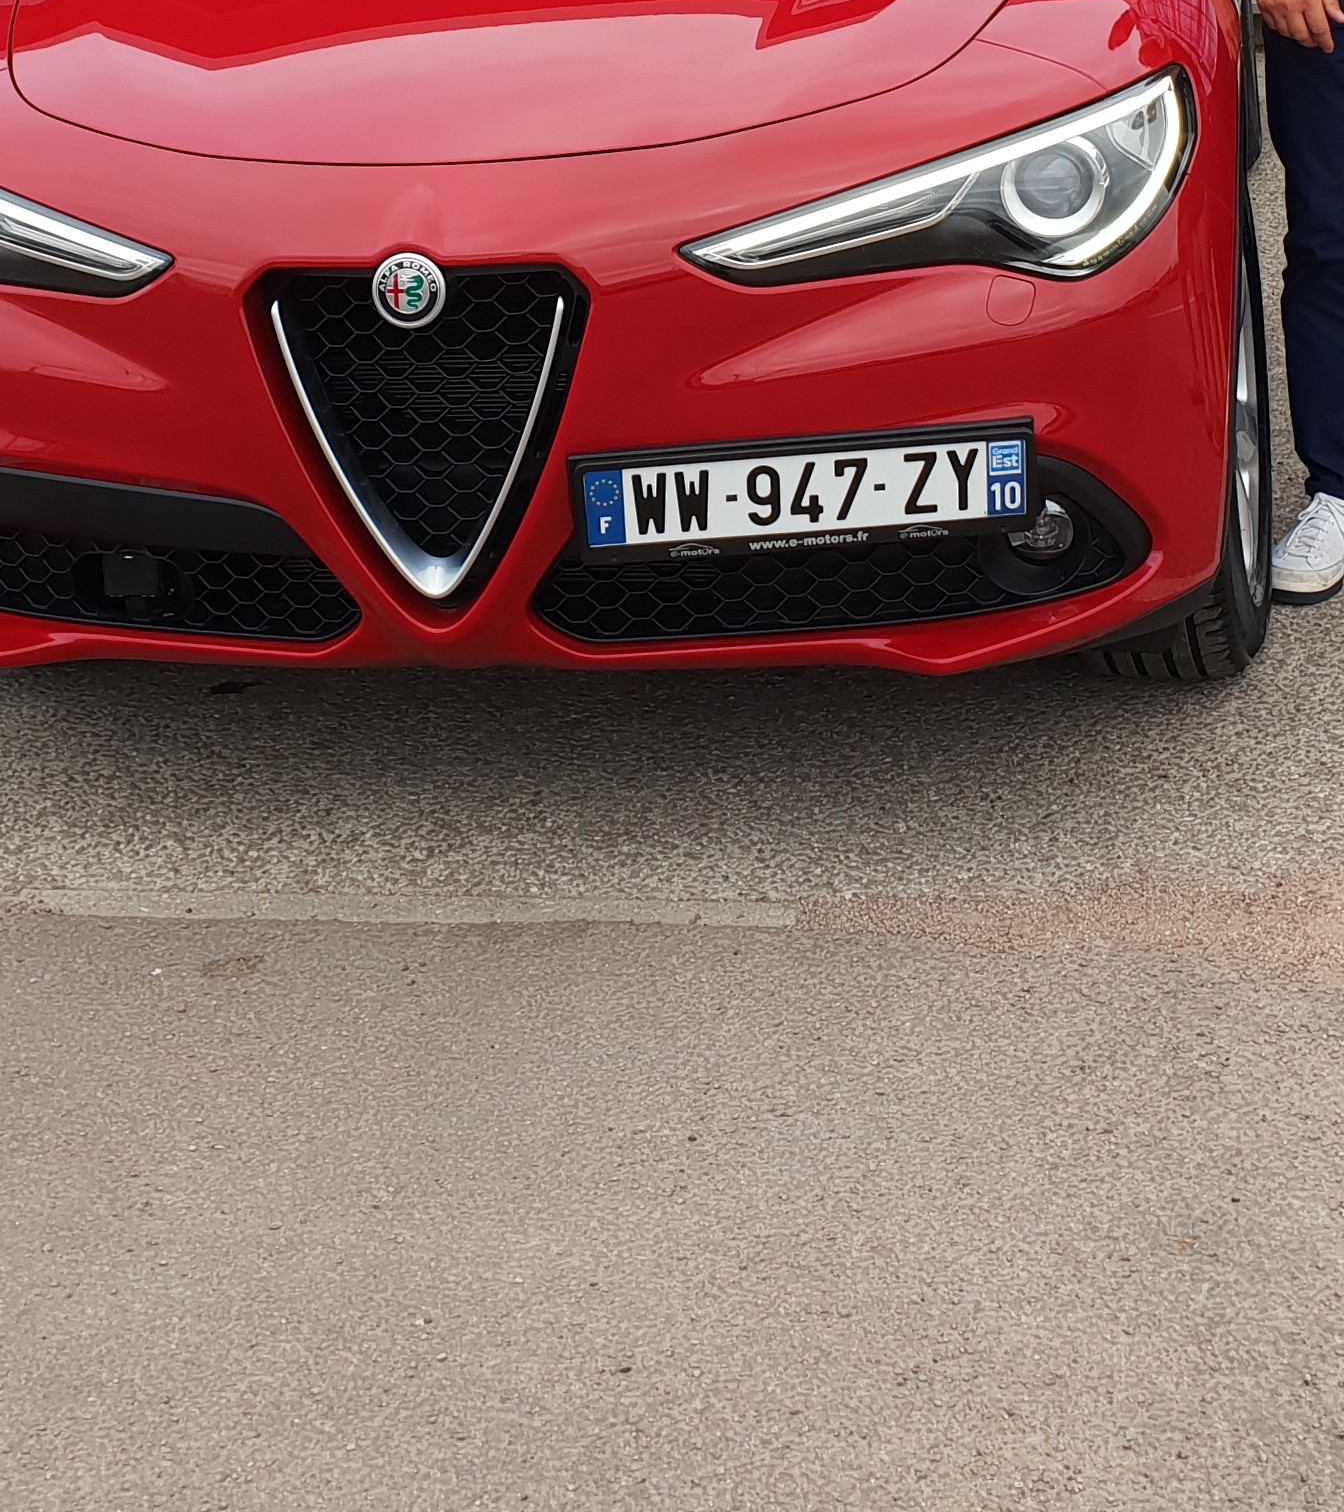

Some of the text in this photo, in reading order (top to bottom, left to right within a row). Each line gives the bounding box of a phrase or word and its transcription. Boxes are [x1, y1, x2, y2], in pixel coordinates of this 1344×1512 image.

[378, 260, 437, 292] ALFA ROMEO
[992, 445, 1019, 456] Grand
[992, 455, 1019, 469] Est
[990, 480, 1022, 511] 10
[599, 516, 613, 535] F
[748, 530, 869, 552] www.e-motors.fr
